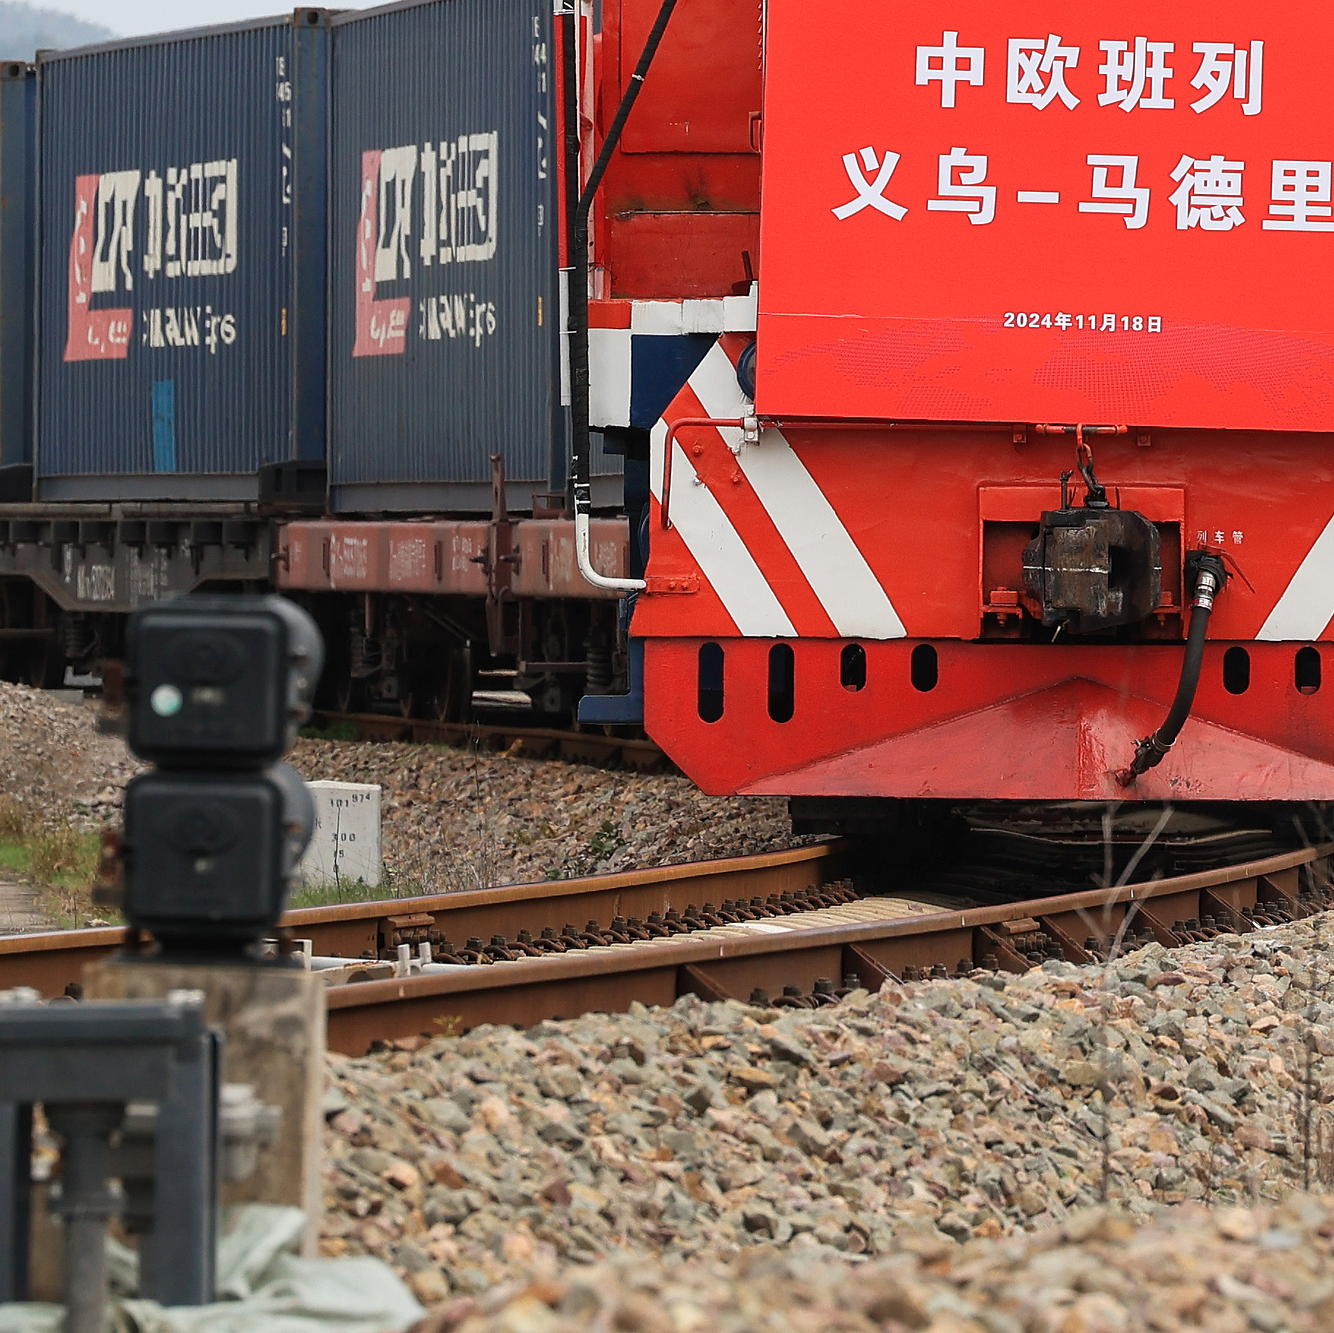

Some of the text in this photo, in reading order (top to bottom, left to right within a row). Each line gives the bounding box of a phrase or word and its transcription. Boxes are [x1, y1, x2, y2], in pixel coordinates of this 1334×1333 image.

[915, 30, 1264, 116] 中欧班列
[1002, 311, 1163, 334] 2024年11月18日
[1196, 530, 1244, 545] 列车管
